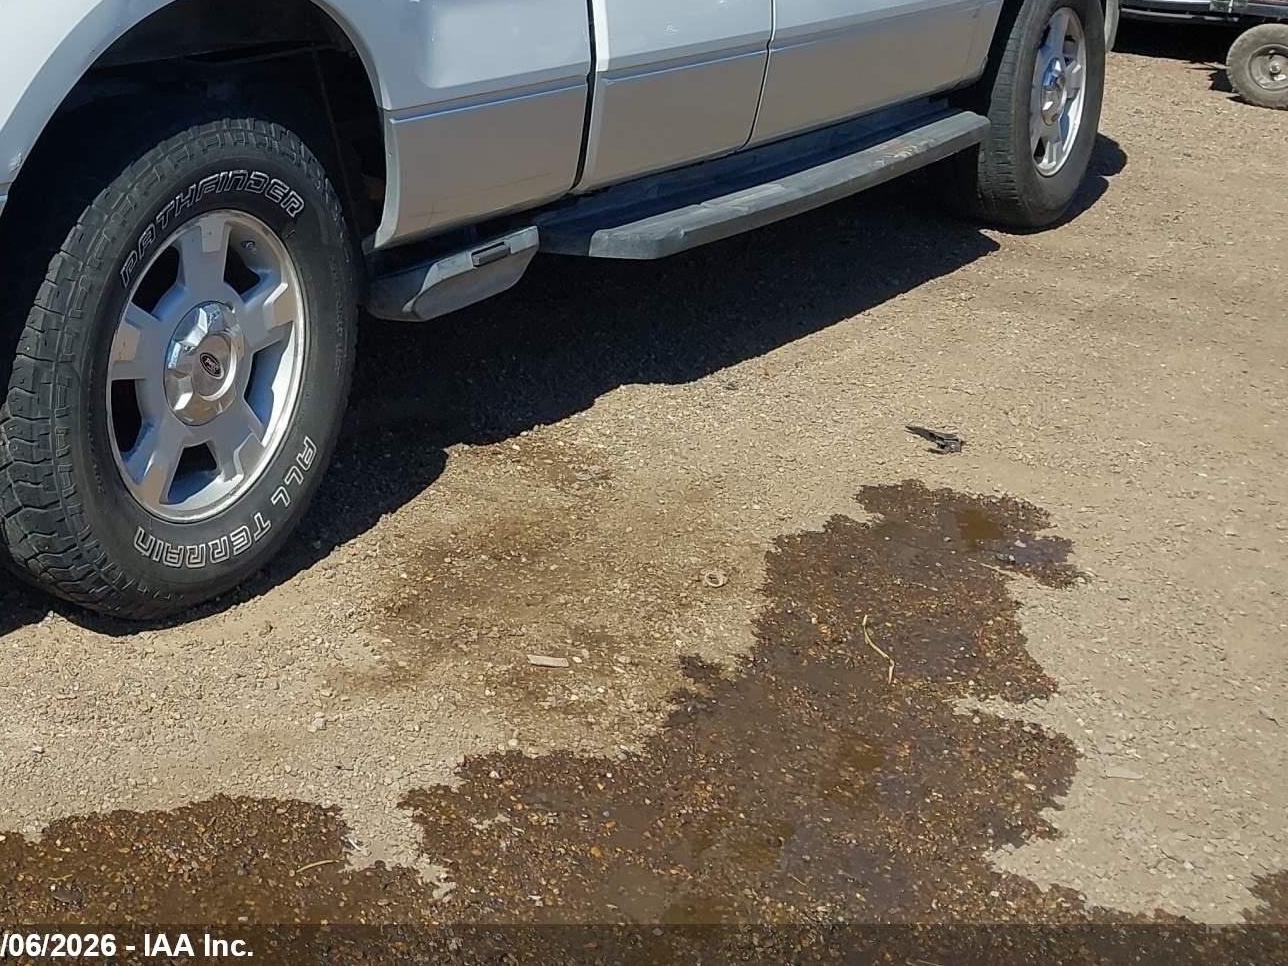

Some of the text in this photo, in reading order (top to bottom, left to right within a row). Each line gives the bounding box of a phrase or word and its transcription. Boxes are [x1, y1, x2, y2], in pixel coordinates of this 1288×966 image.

[120, 170, 305, 288] PATHFINDER
[133, 436, 317, 569] ALL TERRAIN
